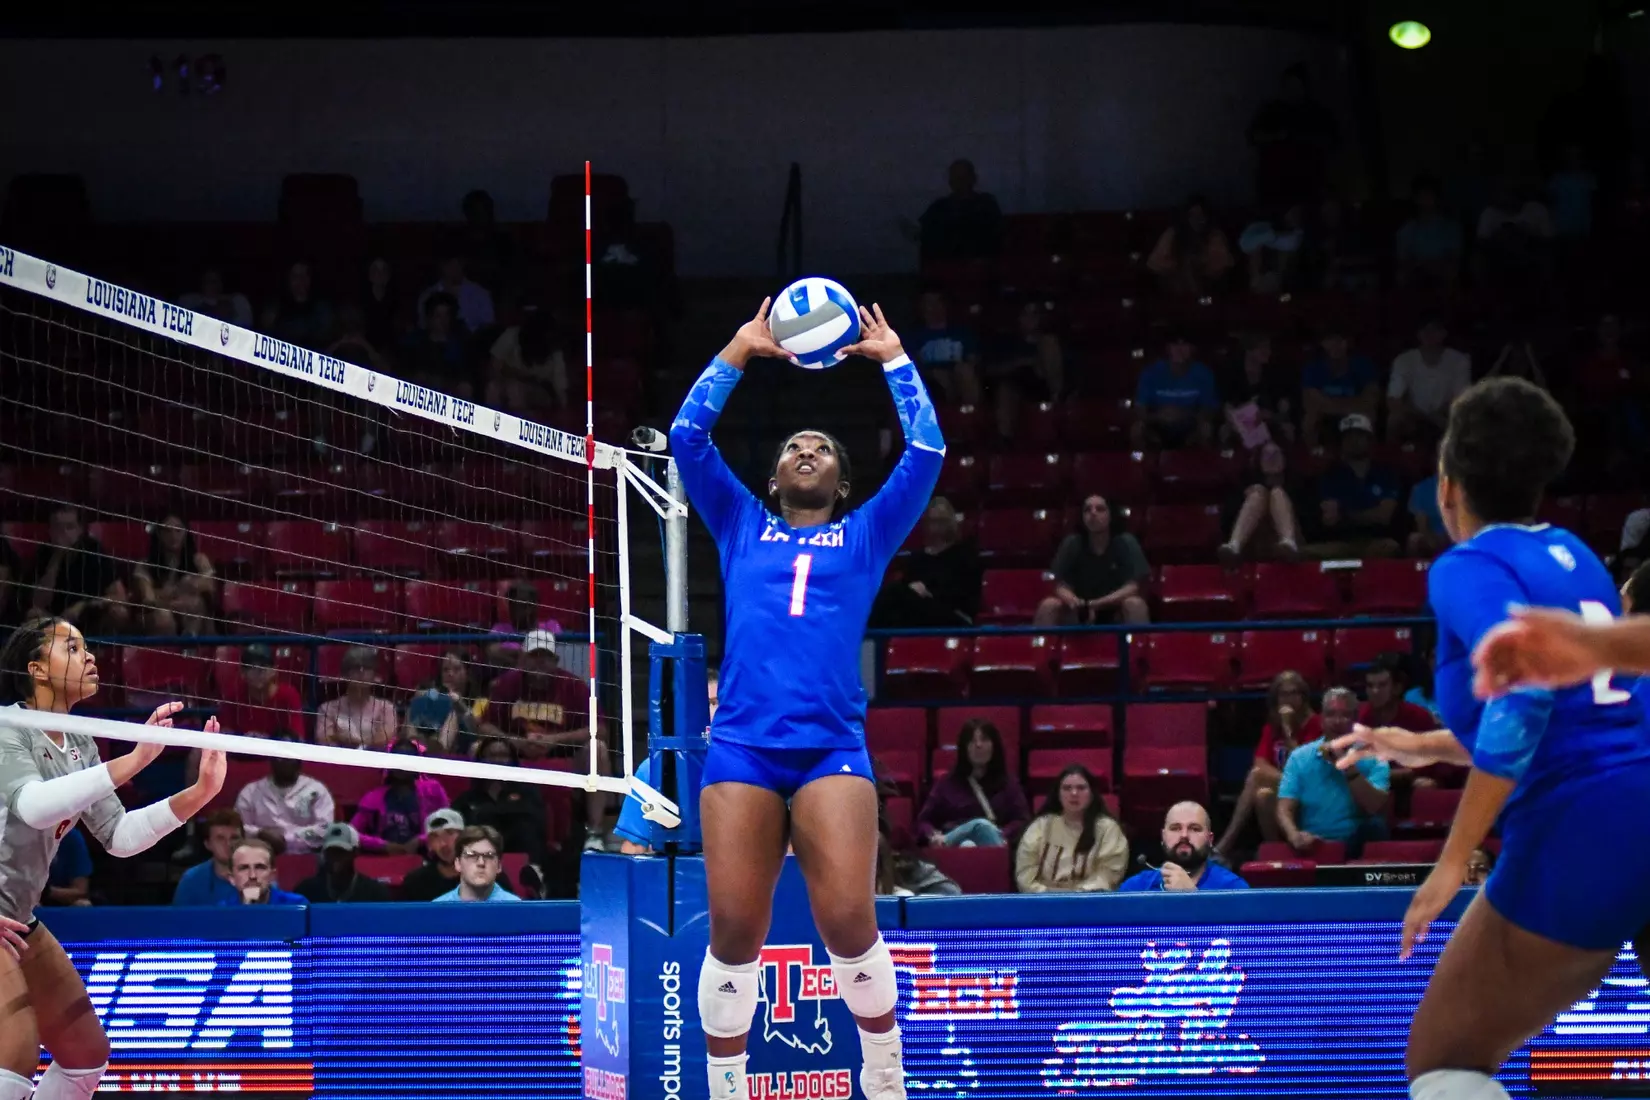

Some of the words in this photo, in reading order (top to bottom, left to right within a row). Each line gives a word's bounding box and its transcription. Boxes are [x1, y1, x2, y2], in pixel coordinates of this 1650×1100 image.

[86, 278, 156, 325] LOUISIANA
[162, 303, 194, 336] TECH
[253, 334, 313, 375] LOUISIANA
[318, 356, 345, 384] TECH
[396, 381, 447, 416] LOUISIANA
[451, 399, 475, 425] TECH
[518, 420, 563, 450] LOUISIANA
[566, 435, 585, 458] TECH
[789, 553, 812, 616] 1
[659, 960, 684, 1040] sports
[759, 944, 842, 1023] TEC
[746, 1069, 852, 1100] ULLDOGS
